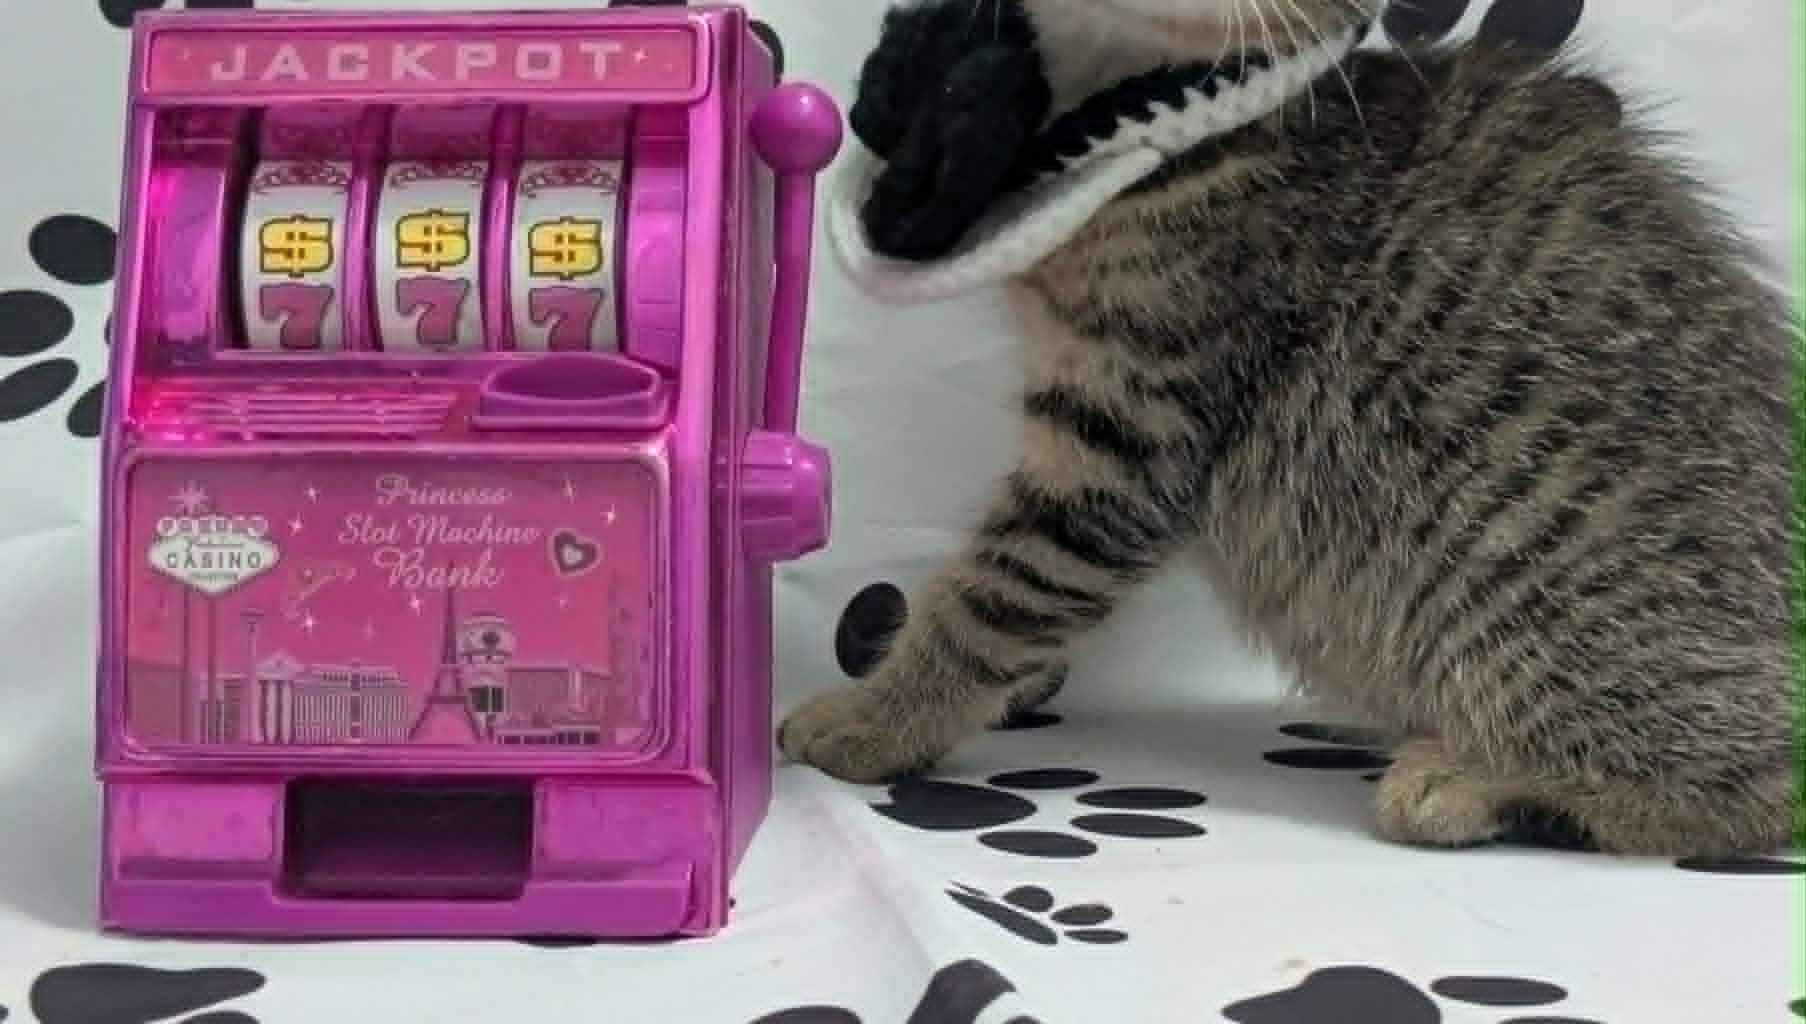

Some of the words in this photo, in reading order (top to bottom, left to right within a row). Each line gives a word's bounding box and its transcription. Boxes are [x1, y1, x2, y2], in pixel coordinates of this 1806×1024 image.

[208, 41, 623, 81] JACKPOT
[259, 215, 333, 278] $
[396, 209, 470, 272] $
[528, 217, 602, 280] $
[259, 283, 334, 350] 7
[396, 277, 471, 346] 7
[528, 286, 604, 352] 7
[376, 474, 512, 504] Princess
[337, 512, 399, 544] Slot
[408, 513, 541, 544] Machine
[167, 551, 262, 569] CASINO
[373, 547, 504, 588] Bank
